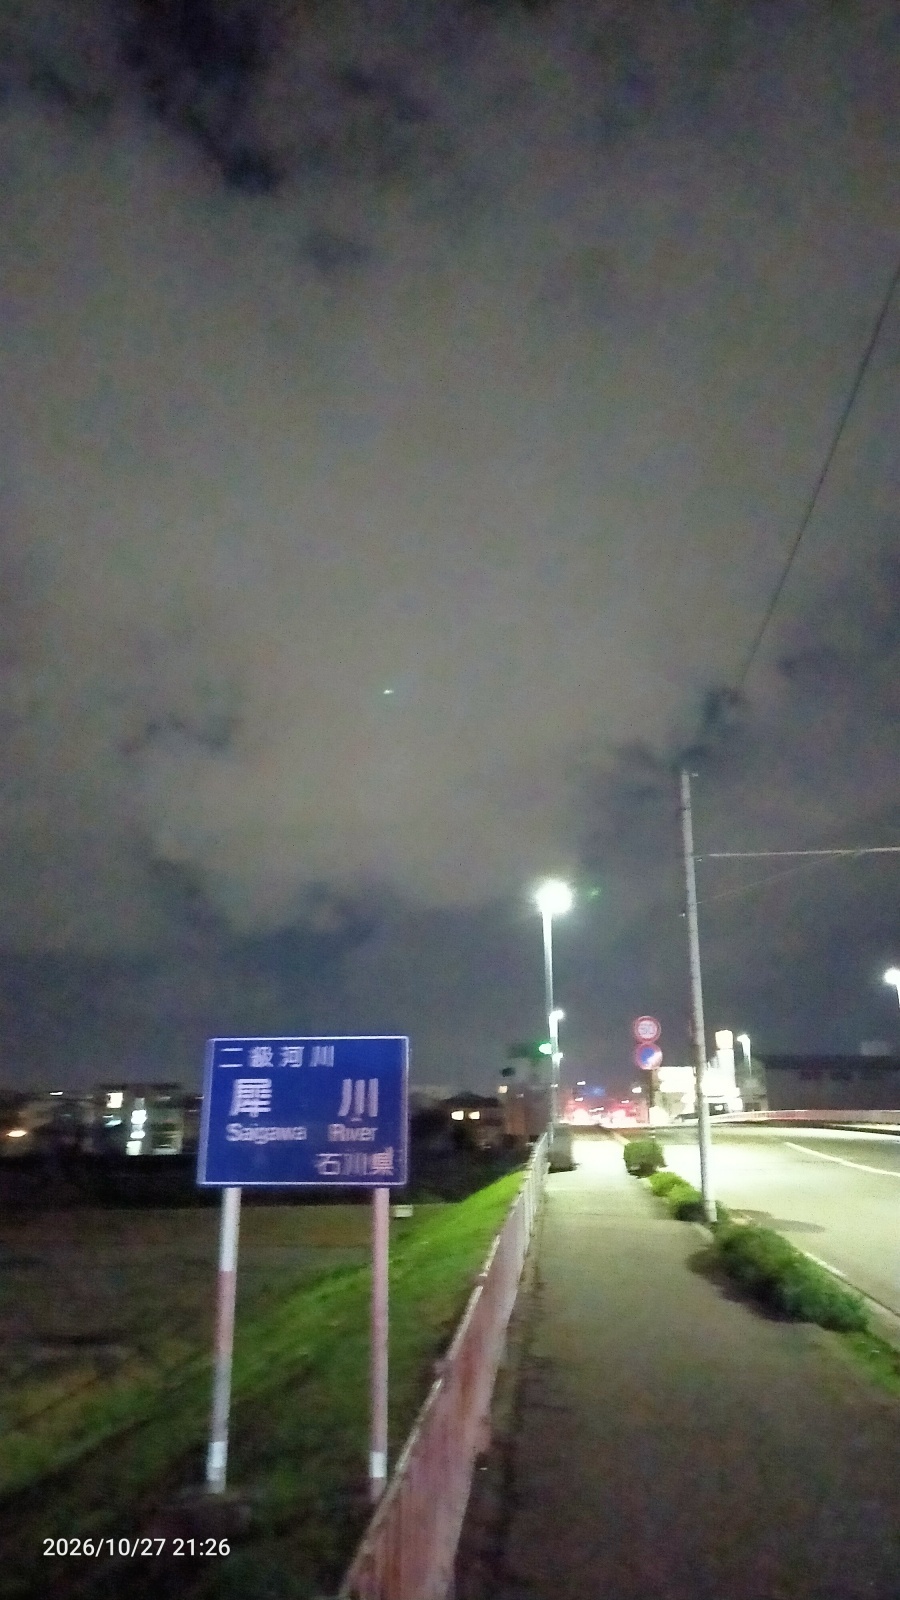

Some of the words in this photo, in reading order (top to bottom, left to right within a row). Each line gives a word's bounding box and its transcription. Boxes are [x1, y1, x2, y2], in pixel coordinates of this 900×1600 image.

[218, 1045, 335, 1068] 二級河川
[225, 1122, 308, 1145] Saigawa
[327, 1122, 379, 1142] River
[314, 1146, 395, 1176] 石川県
